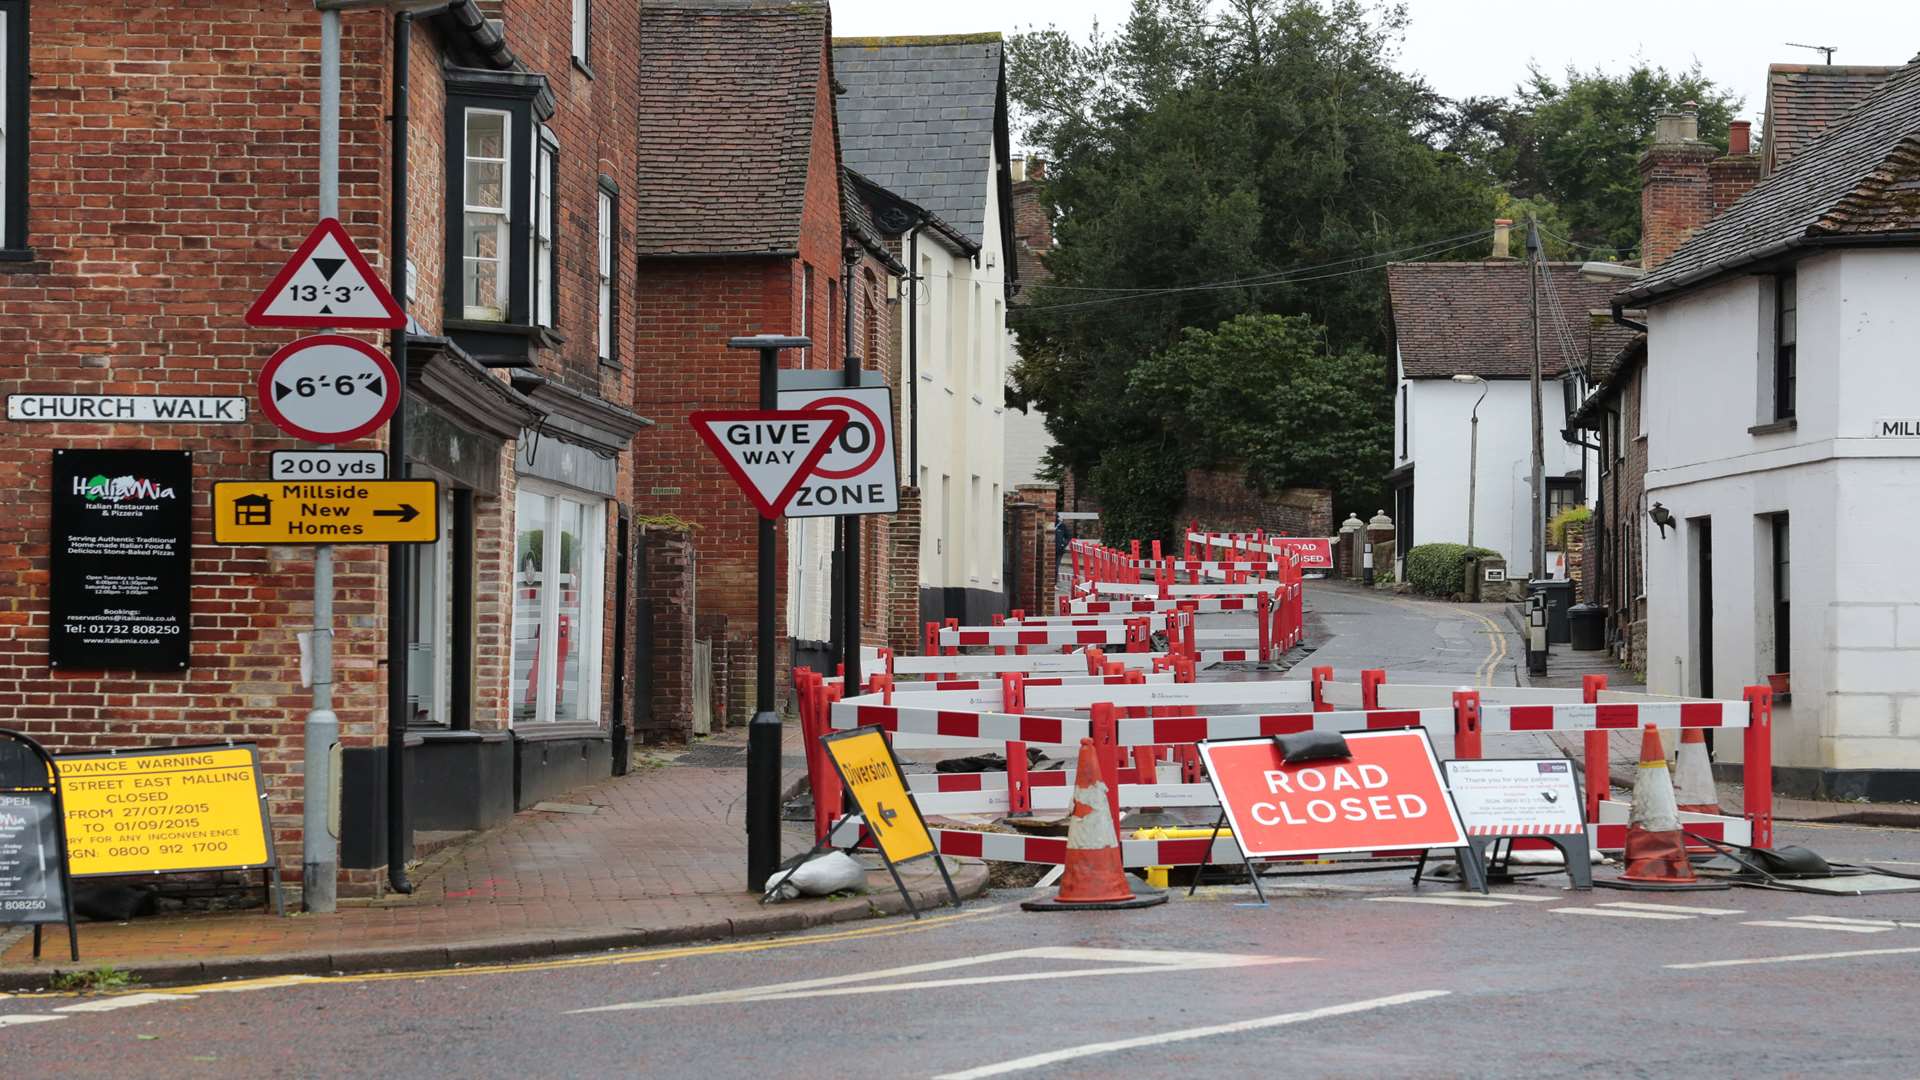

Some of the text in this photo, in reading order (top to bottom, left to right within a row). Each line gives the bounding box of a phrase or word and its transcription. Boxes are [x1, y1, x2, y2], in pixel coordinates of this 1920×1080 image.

[20, 398, 234, 419] CHURCH WALK
[726, 424, 810, 445] GIVE
[823, 421, 870, 453] 0
[742, 451, 795, 465] WAY
[280, 459, 376, 478] 200 yds
[282, 485, 368, 499] Millside
[796, 484, 885, 506] ZONE
[301, 504, 350, 517] New
[288, 522, 364, 535] Homes
[1288, 543, 1317, 551] OAD
[64, 624, 180, 634] Tel: 01732 808250
[62, 755, 214, 773] DVANCE WARNING
[842, 758, 892, 786] Diversion
[68, 771, 250, 792] STREET EAST MALLING
[1263, 763, 1389, 794] ROAD
[106, 791, 169, 804] CLOSED
[69, 803, 210, 819] FROM 27/07/2015
[1251, 794, 1428, 826] CLOSED
[84, 818, 200, 833] TO 01/09/2015
[90, 835, 113, 843] FOR
[120, 834, 141, 842] ANY
[109, 846, 150, 857] 0800
[160, 844, 184, 854] 912
[192, 841, 228, 852] 1700
[4, 900, 46, 910] 808250
